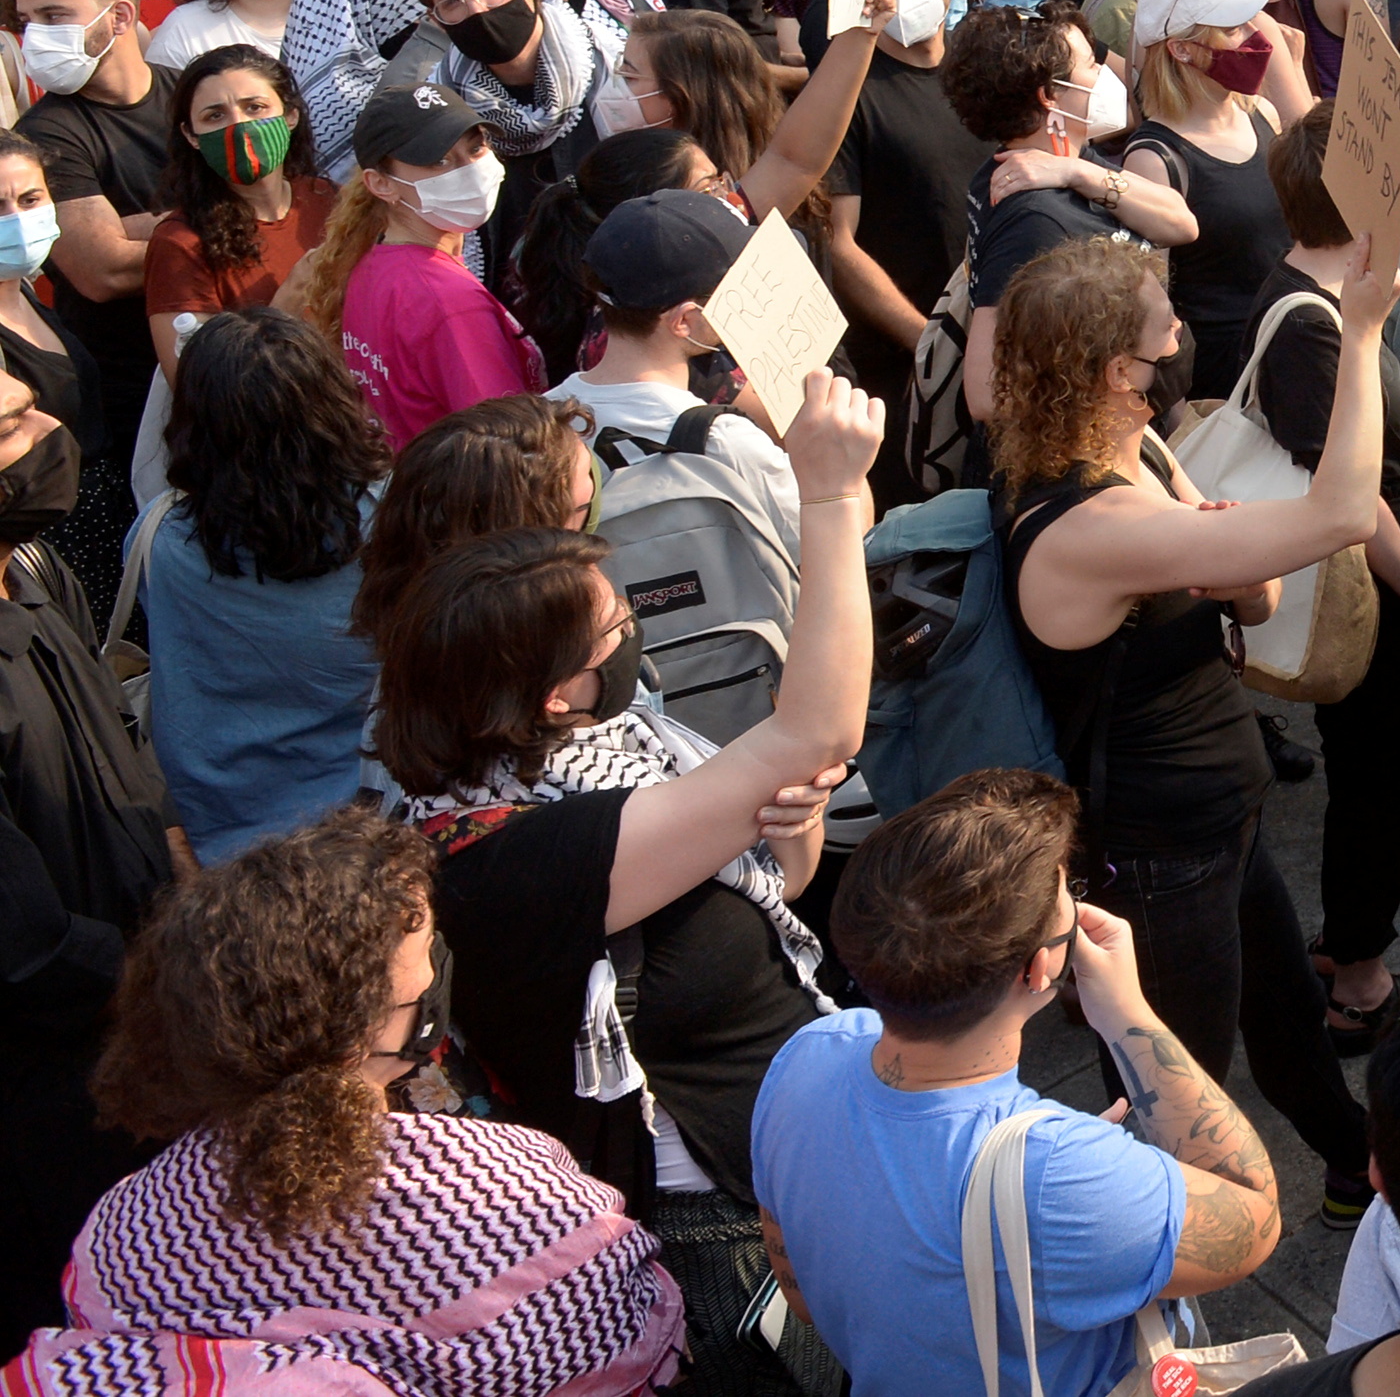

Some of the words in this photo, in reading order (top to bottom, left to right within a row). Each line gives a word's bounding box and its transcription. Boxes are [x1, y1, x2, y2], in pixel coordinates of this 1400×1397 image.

[1352, 12, 1376, 62] THIS
[1336, 111, 1375, 174] STAND
[1380, 162, 1400, 216] BY
[711, 254, 782, 350] FREE
[750, 280, 840, 419] PALESTINE
[632, 581, 698, 610] JANSPORT
